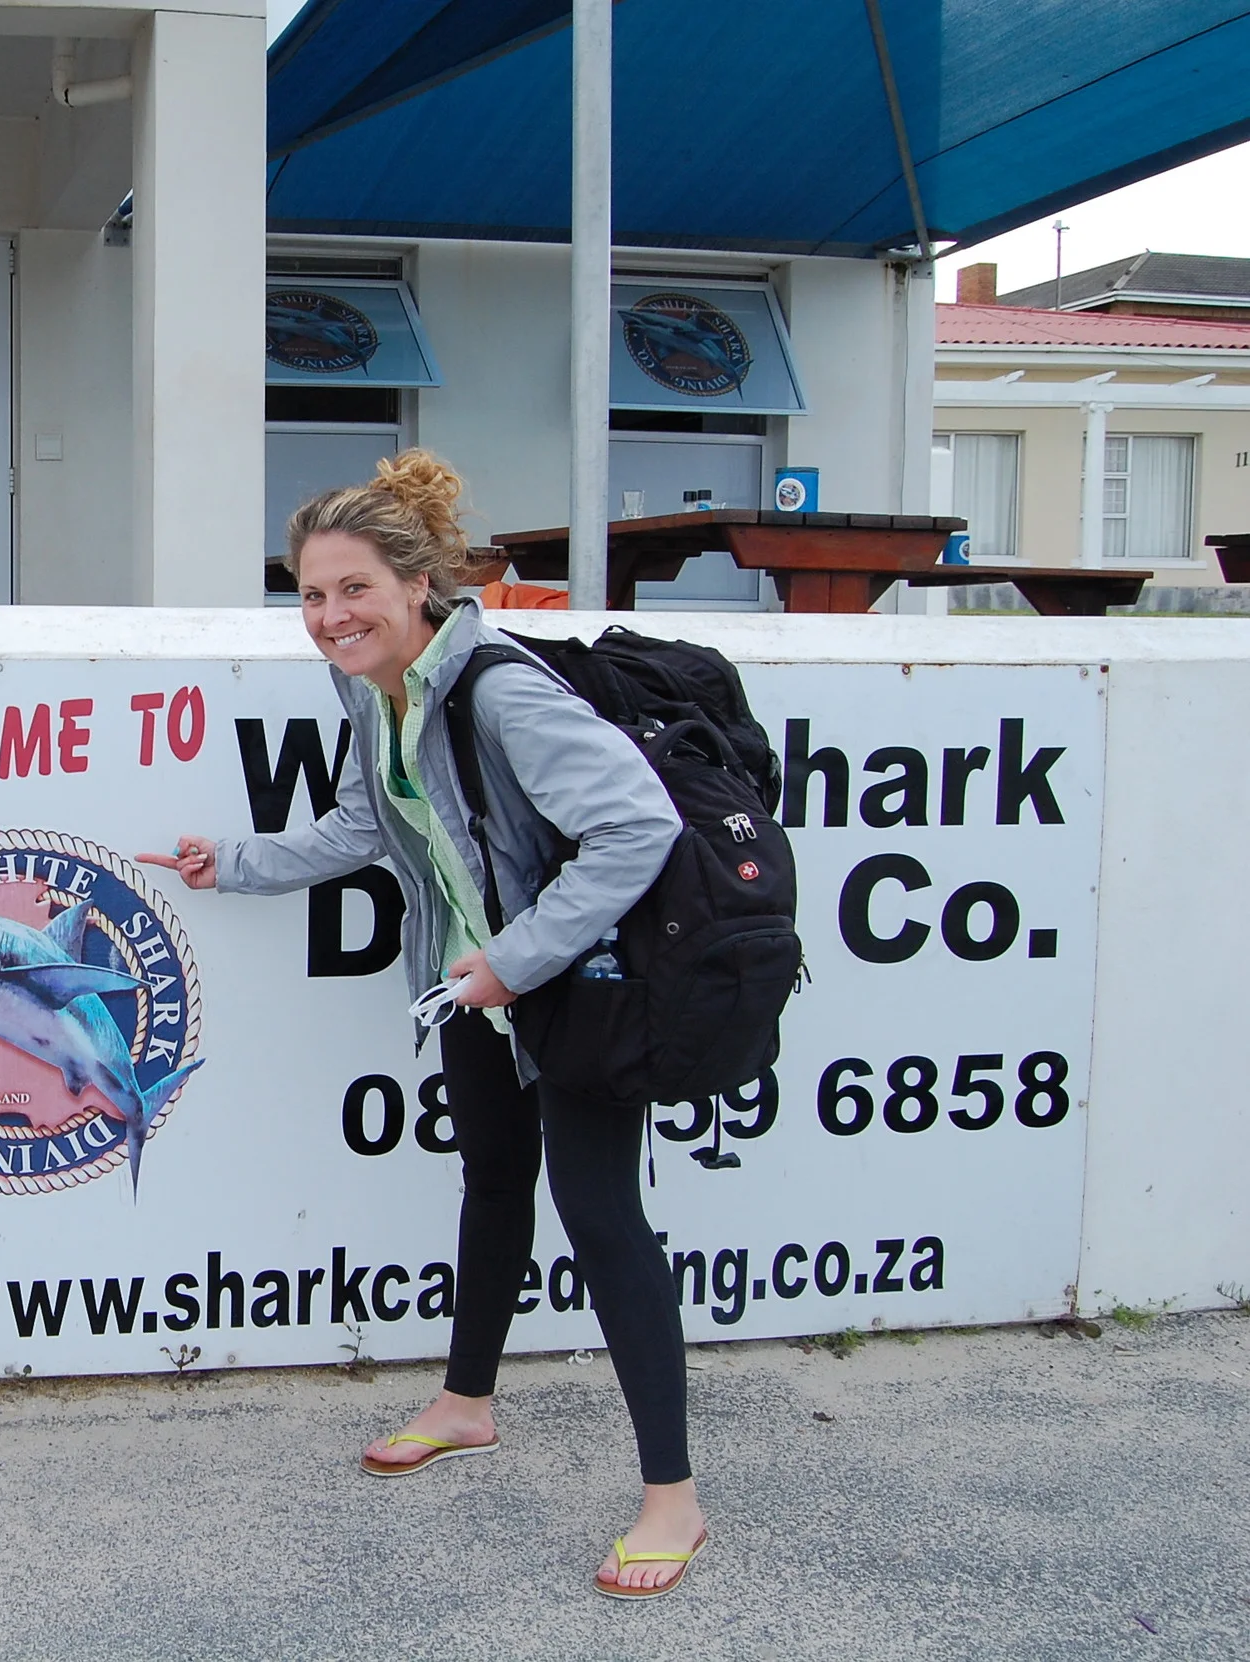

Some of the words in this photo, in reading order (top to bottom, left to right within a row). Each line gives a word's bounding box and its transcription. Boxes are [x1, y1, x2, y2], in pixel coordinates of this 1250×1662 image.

[675, 374, 729, 390] DIVING
[714, 317, 743, 362] SHARK
[131, 685, 206, 768] TO
[782, 717, 1068, 828] hark
[838, 853, 1058, 964] Co.
[120, 911, 180, 1068] SHARK
[817, 1050, 1070, 1137] 6858
